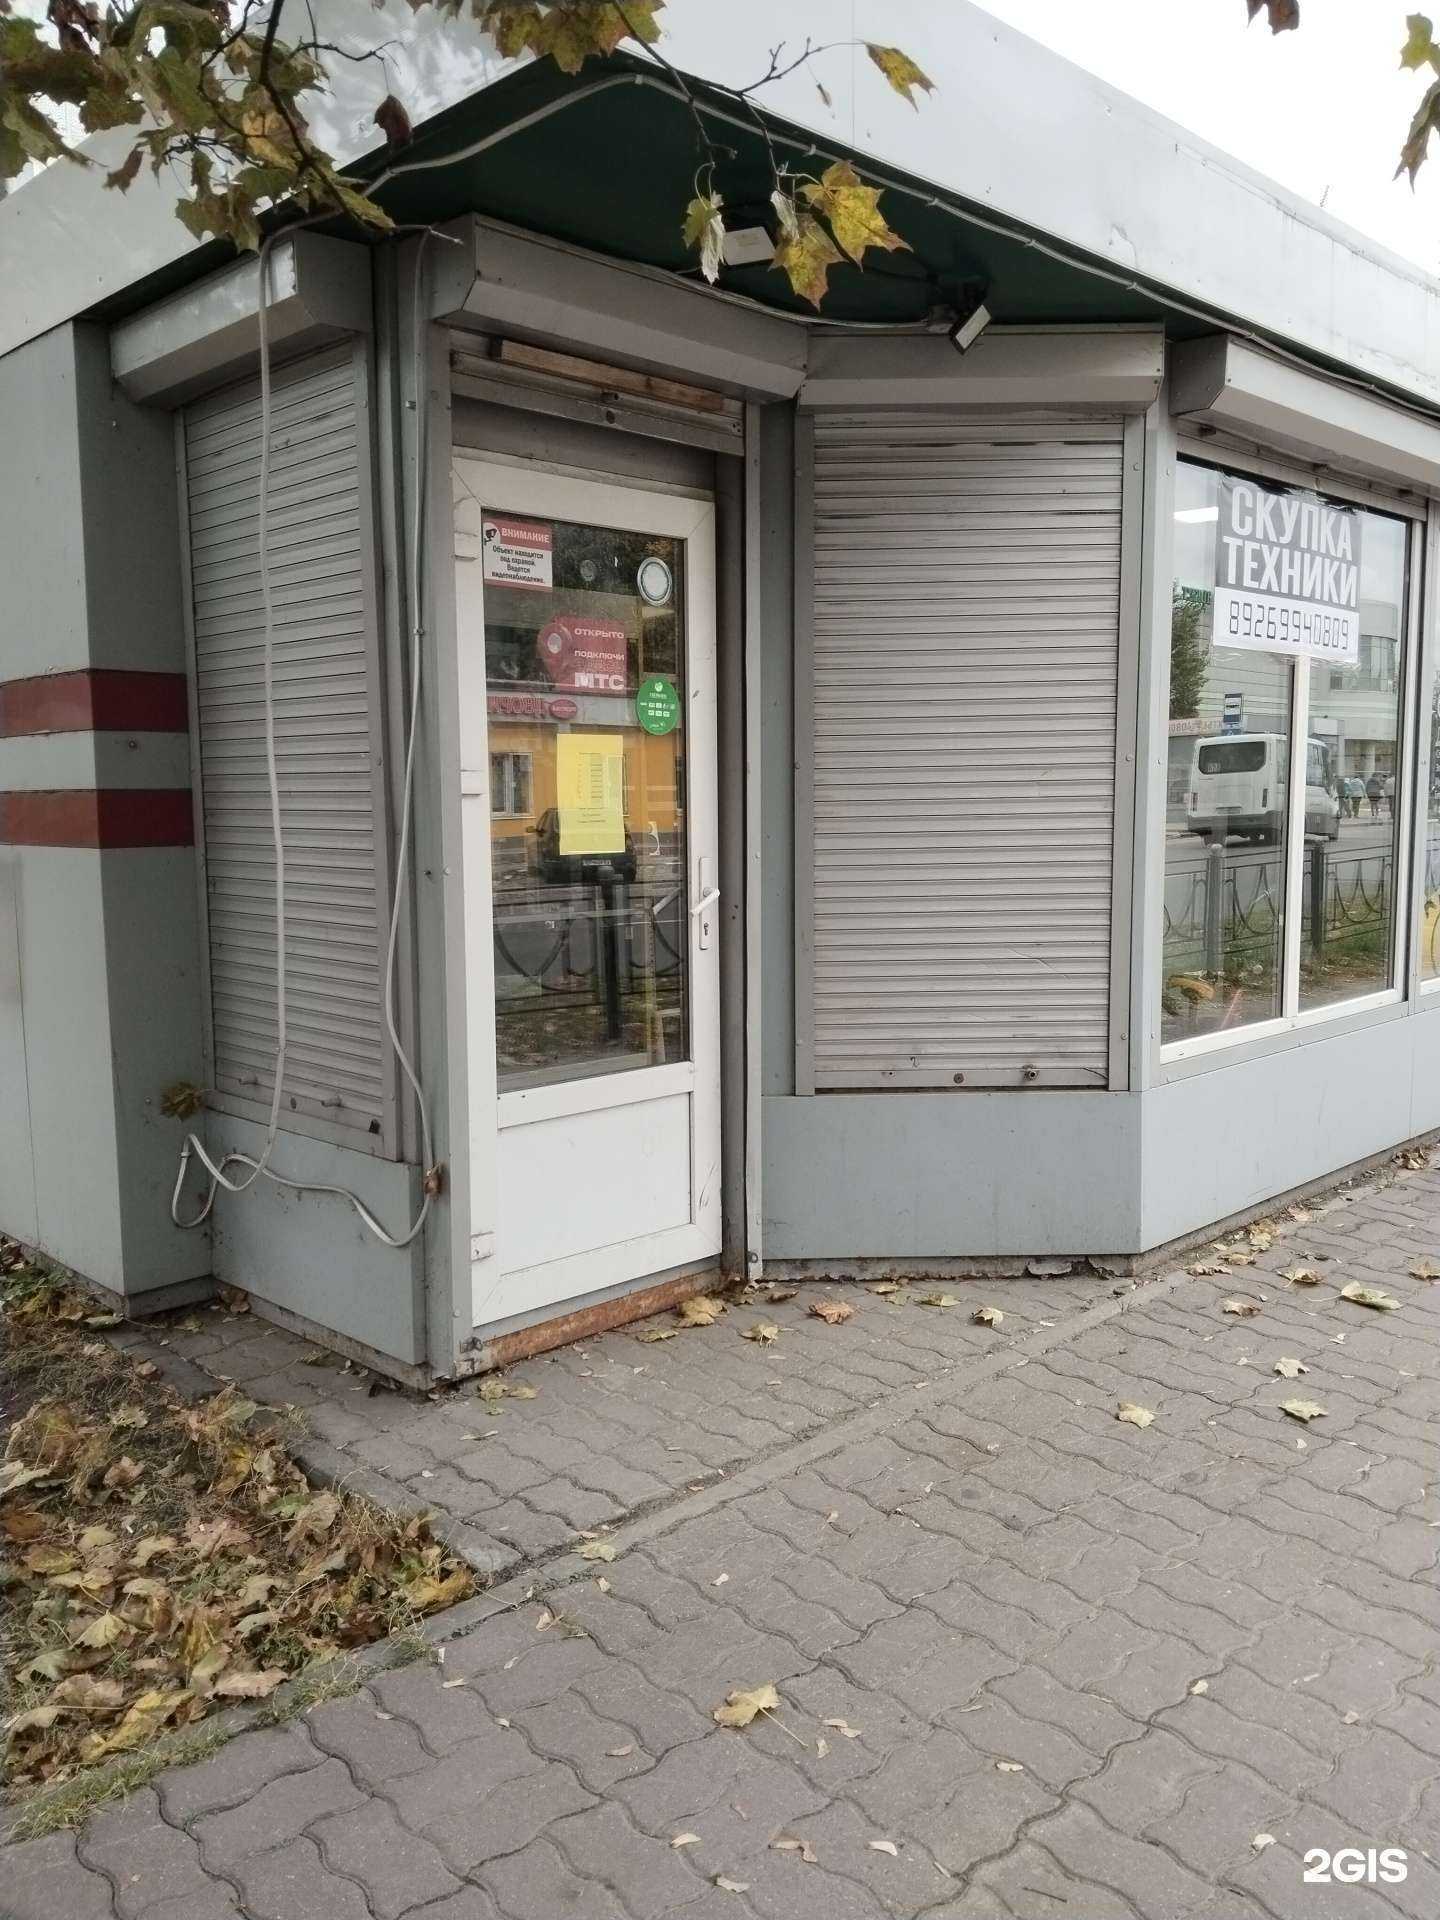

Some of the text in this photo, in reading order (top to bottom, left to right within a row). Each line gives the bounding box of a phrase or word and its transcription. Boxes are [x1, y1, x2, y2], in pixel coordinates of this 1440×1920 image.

[501, 527, 550, 543] ВНИМАНИЕ
[1232, 486, 1353, 561] СКУПКА
[1222, 535, 1358, 608] ТЕХНИКИ
[574, 628, 625, 639] ОТКРЫТО
[1229, 600, 1349, 650] 89269940809
[574, 672, 625, 690] МТС
